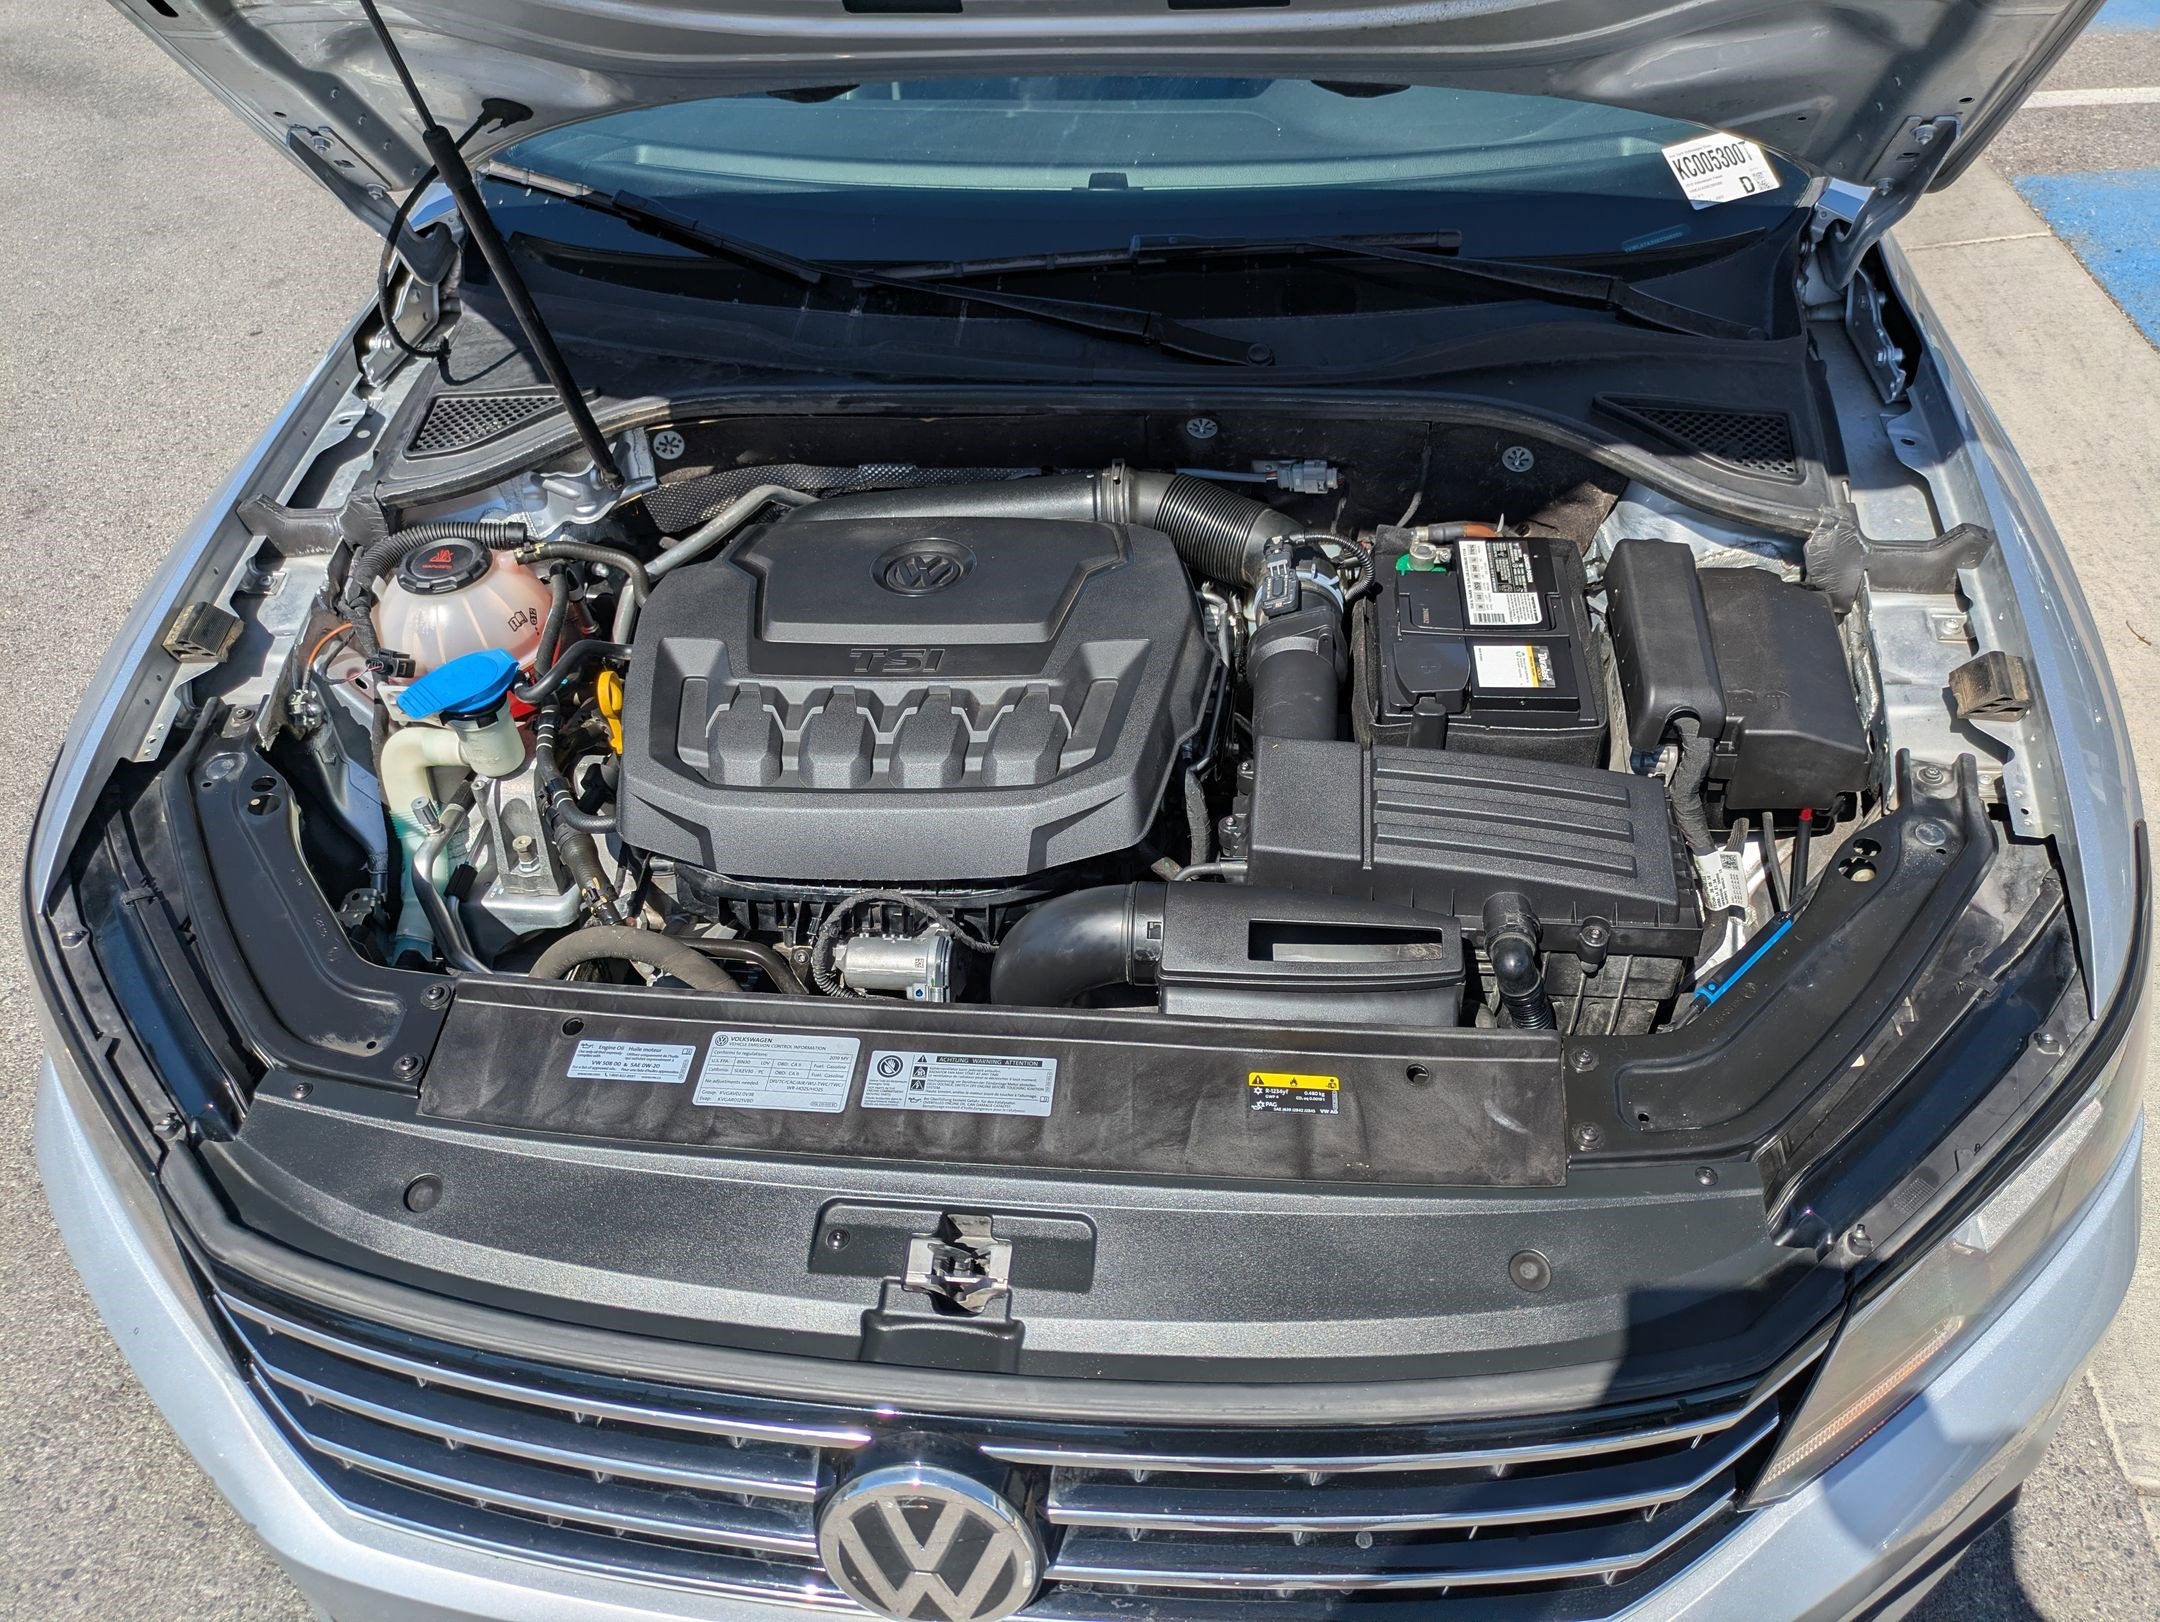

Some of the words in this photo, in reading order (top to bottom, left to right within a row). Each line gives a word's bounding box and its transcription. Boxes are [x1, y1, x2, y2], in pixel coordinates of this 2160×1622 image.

[1739, 176, 1755, 194] D
[850, 648, 945, 673] TSI
[1538, 652, 1552, 681] Duralast
